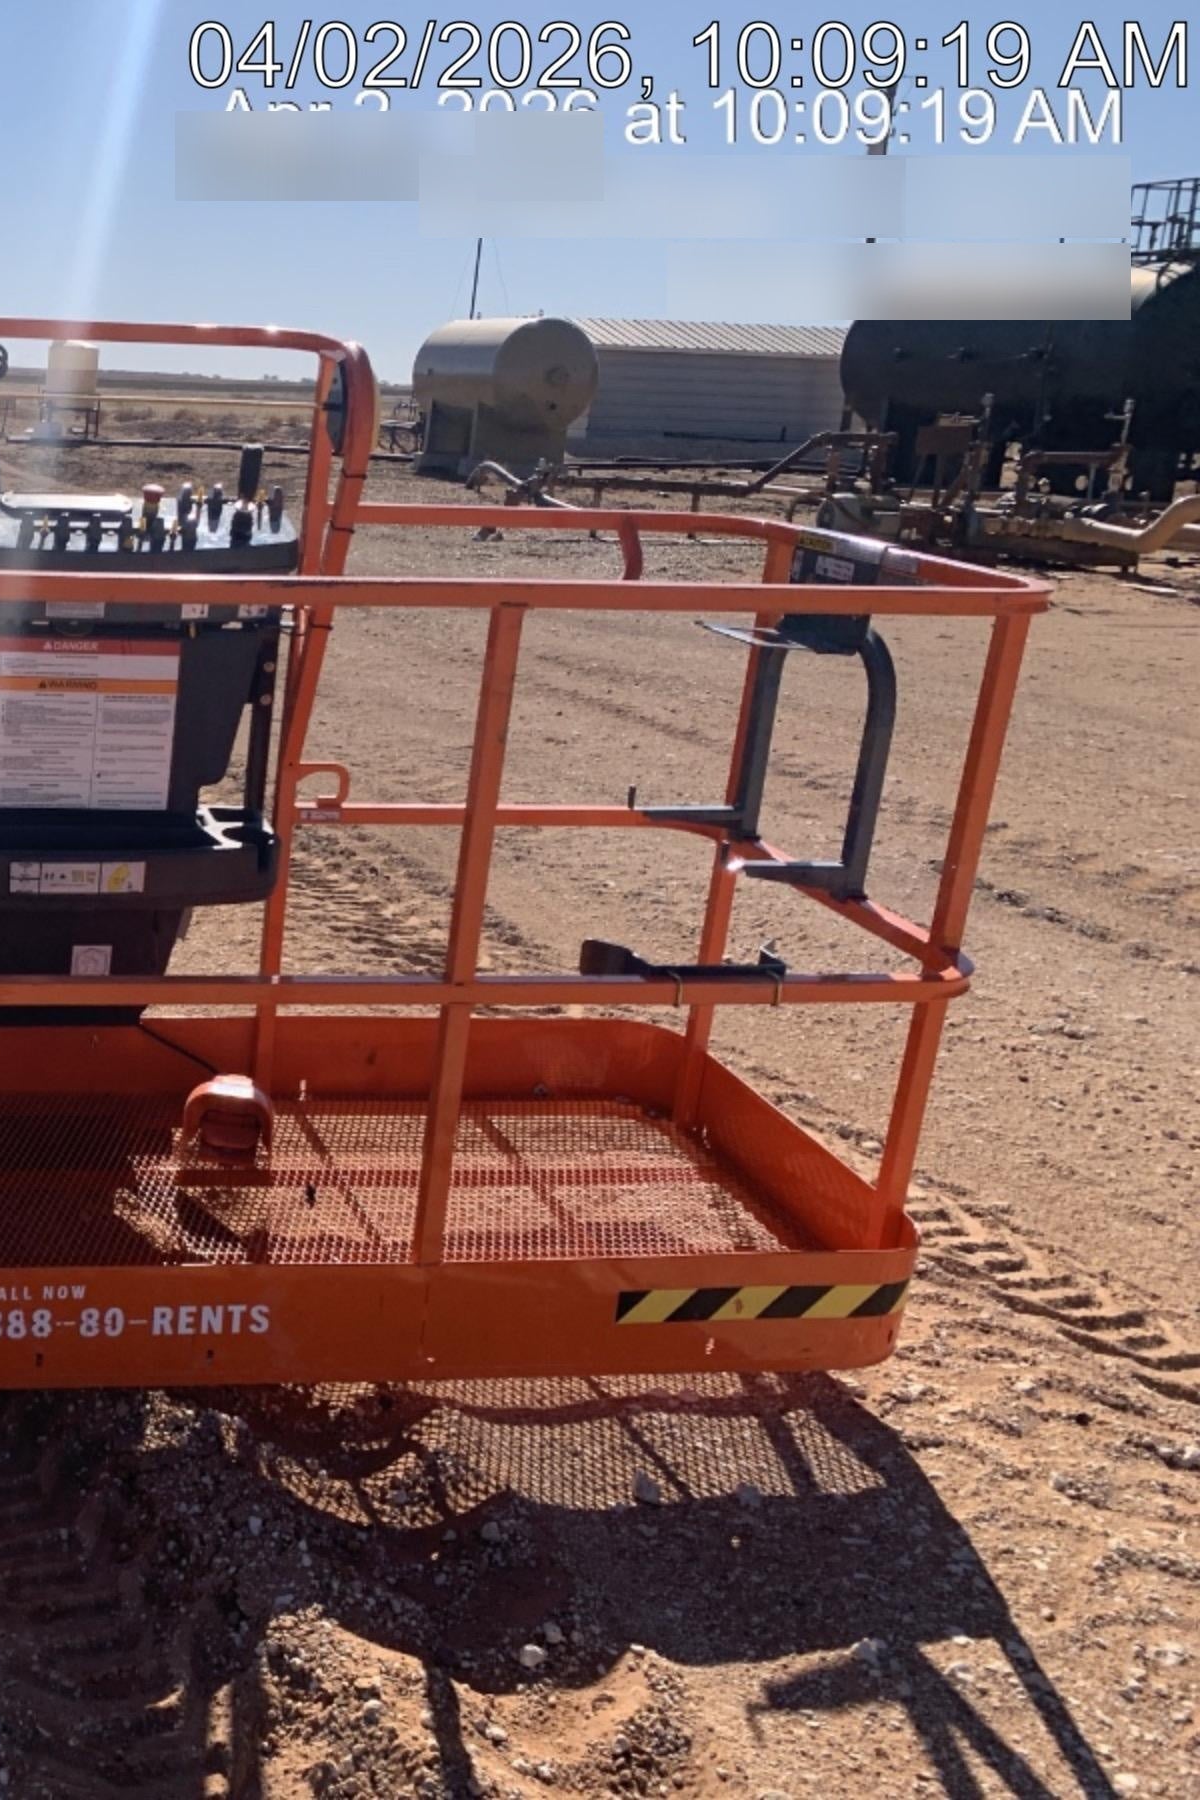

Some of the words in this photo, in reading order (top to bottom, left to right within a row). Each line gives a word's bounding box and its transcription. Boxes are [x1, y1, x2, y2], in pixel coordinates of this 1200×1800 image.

[54, 641, 97, 651] DANGER
[48, 680, 97, 690] WARNING
[43, 1285, 87, 1299] NOW
